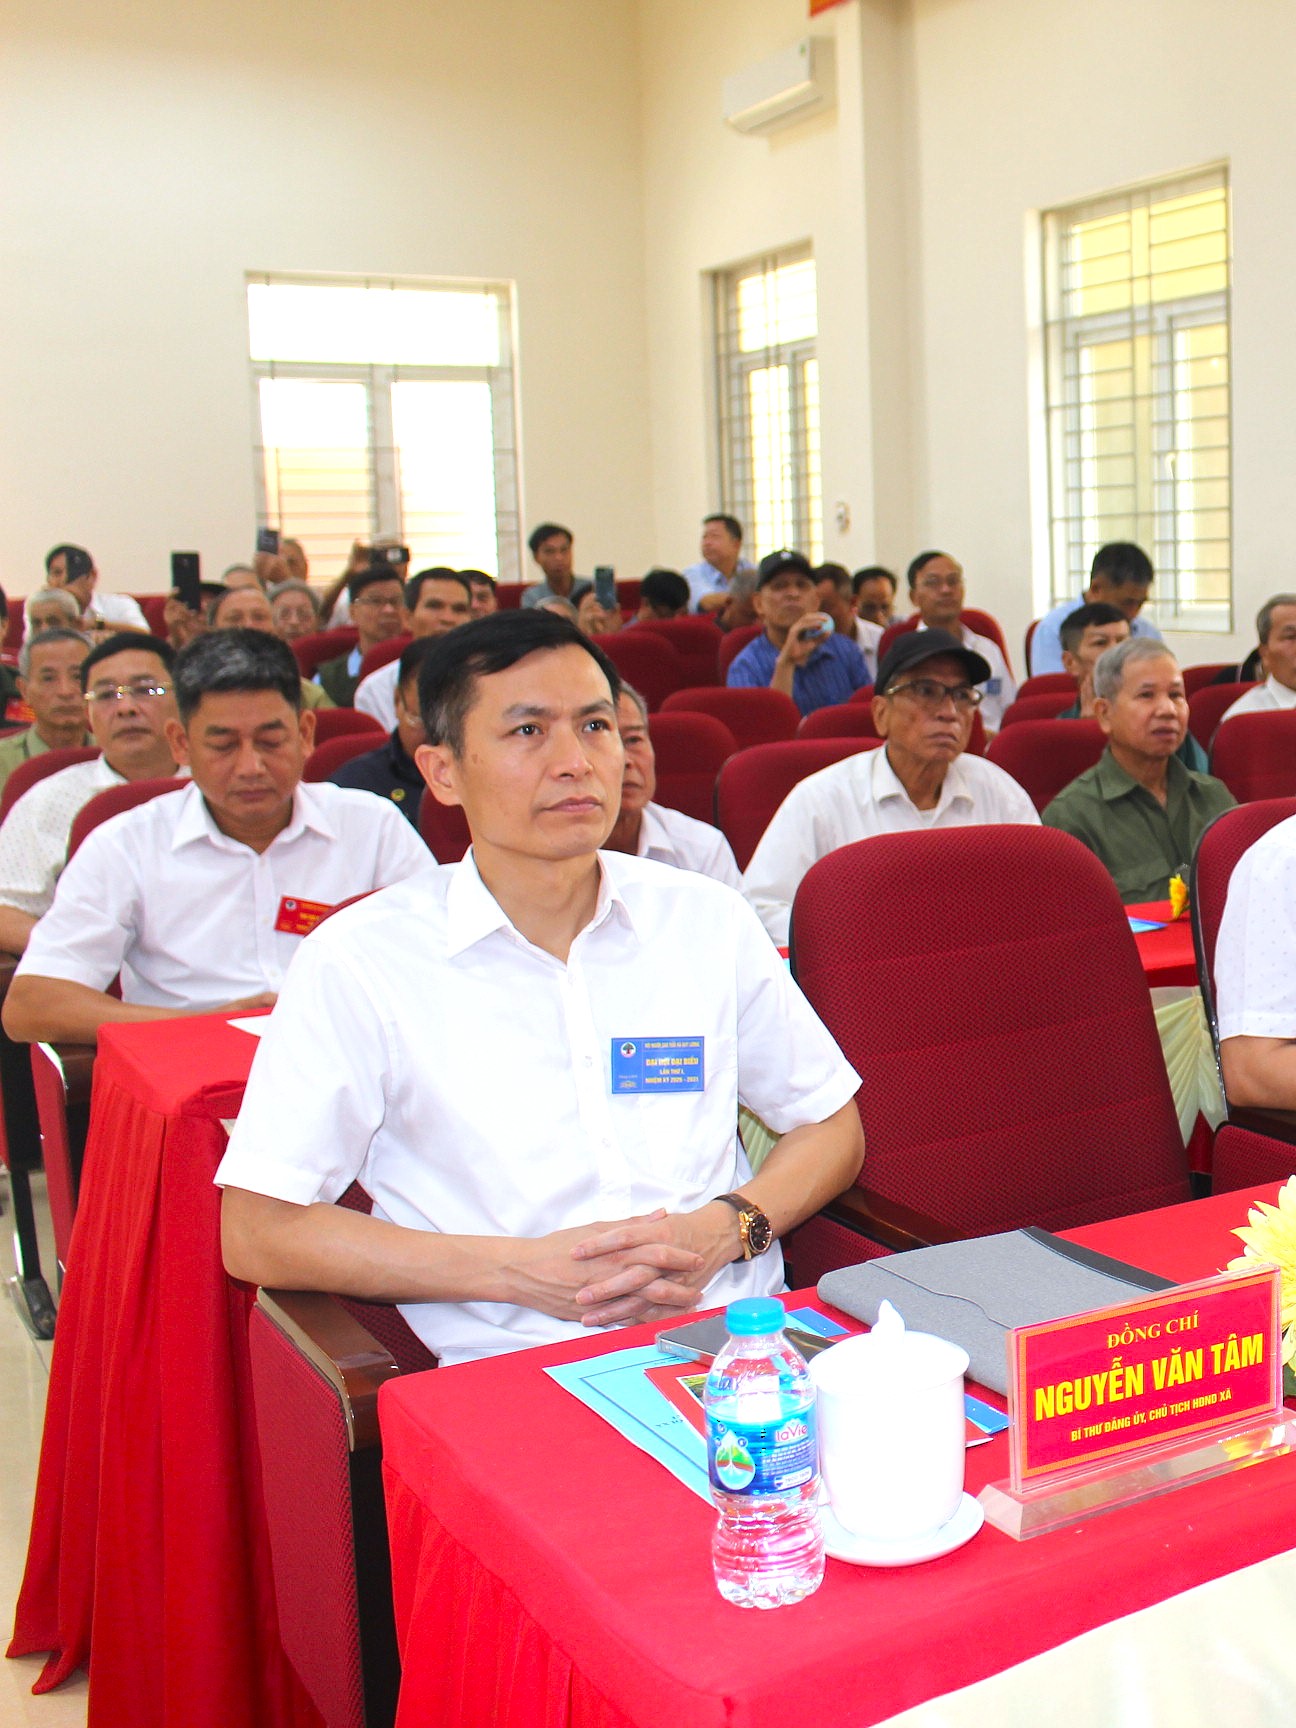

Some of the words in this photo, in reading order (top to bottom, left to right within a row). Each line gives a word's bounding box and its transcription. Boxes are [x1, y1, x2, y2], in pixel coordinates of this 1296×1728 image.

[1107, 1322, 1161, 1349] ĐỒNG
[1166, 1310, 1199, 1336] CHÍ
[1034, 1356, 1144, 1422] NGUYỄN
[1152, 1346, 1203, 1391] VĂN
[1211, 1332, 1263, 1375] TÂM
[776, 1423, 808, 1442] laVie
[1083, 1423, 1103, 1438] THƯ
[1149, 1403, 1169, 1421] CHỦ
[1169, 1398, 1191, 1417] TỊCH
[1219, 1387, 1233, 1402] XÃ
